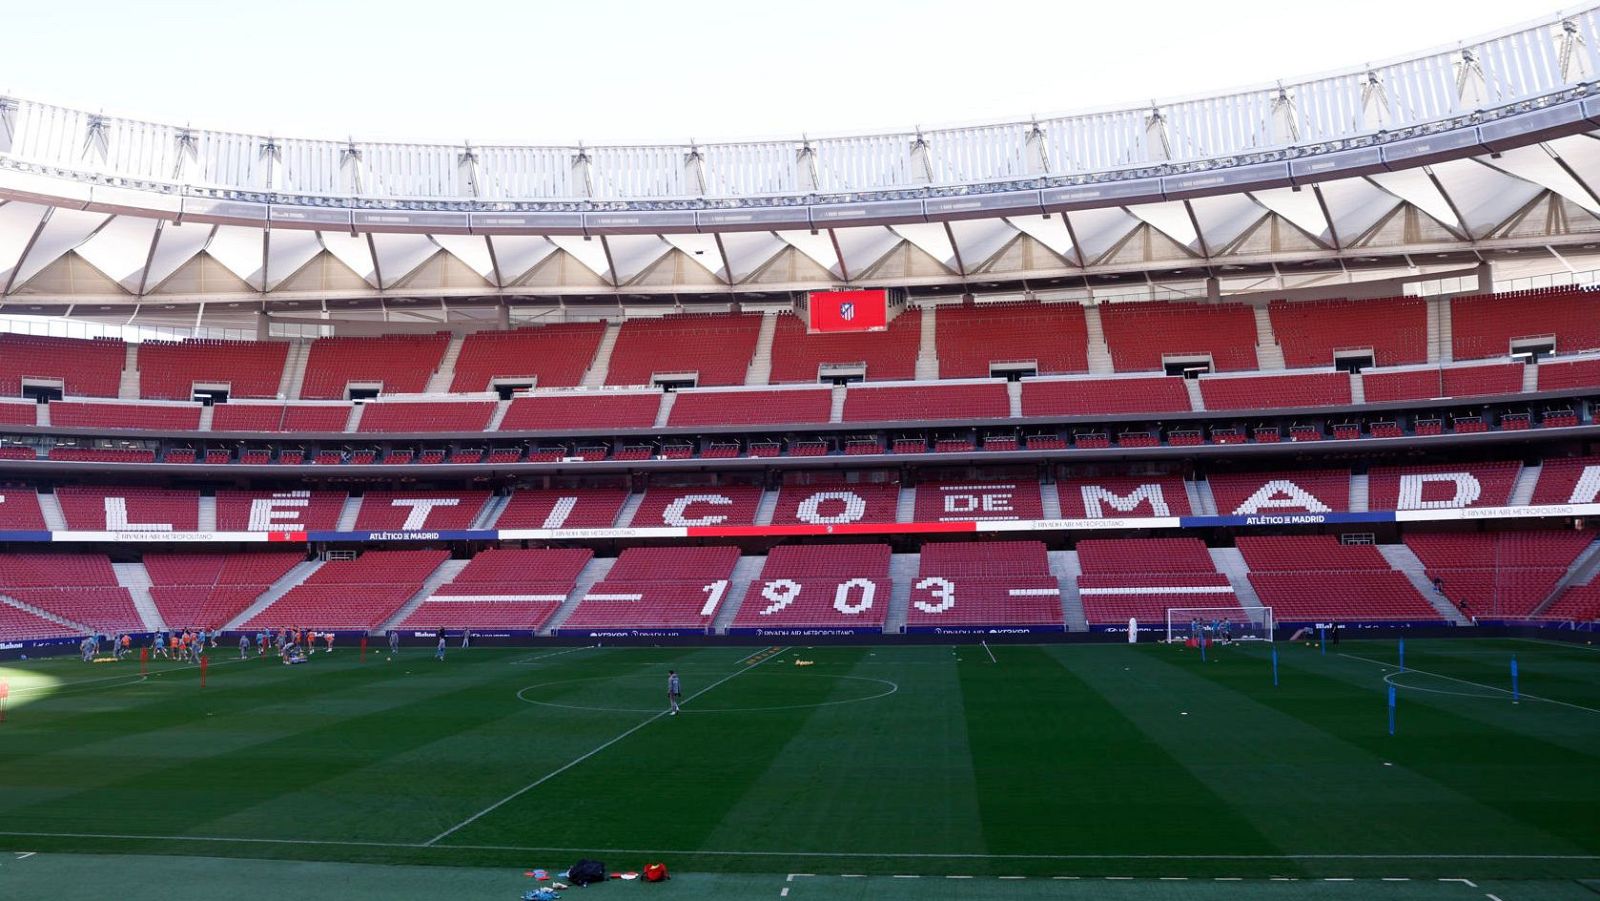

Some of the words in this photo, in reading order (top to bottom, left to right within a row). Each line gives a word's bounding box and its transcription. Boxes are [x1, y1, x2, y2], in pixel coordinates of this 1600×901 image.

[944, 493, 1014, 512] DE
[1246, 515, 1283, 524] ATLÉTICO
[1291, 515, 1325, 523] MADRID
[369, 531, 403, 540] ATLÉTICO
[410, 532, 439, 540] MADRID
